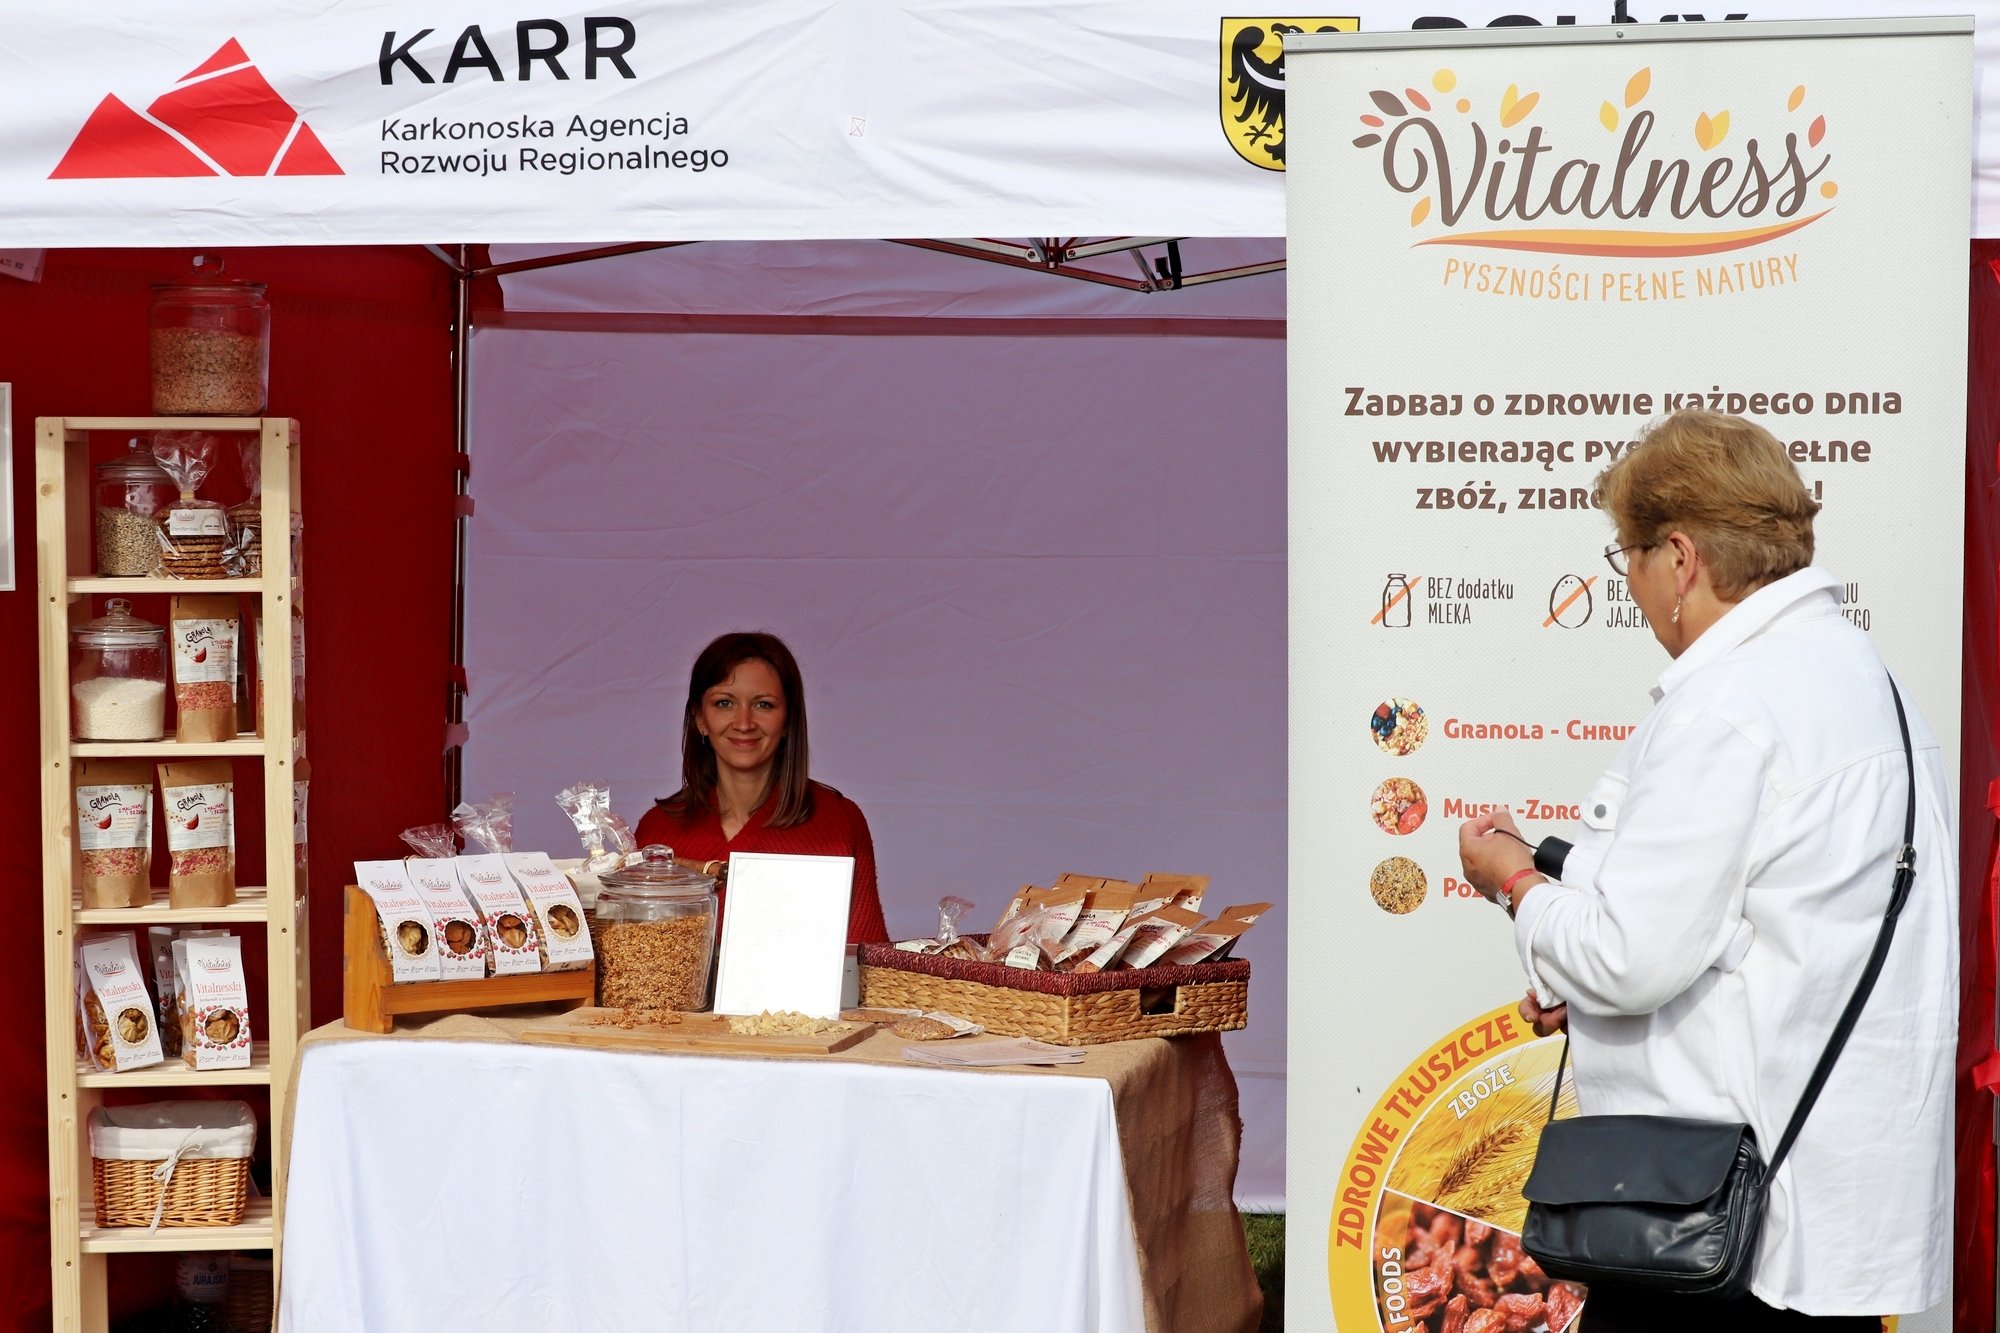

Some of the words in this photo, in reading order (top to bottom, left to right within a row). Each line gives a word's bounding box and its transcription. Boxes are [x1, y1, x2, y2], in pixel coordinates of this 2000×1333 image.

[379, 16, 637, 86] KARR
[381, 115, 555, 141] Karkonoska
[566, 112, 689, 142] Agencja
[381, 148, 507, 177] Rozwoju
[520, 144, 729, 175] Regionalnego
[1383, 109, 1832, 227] Vitalness
[1443, 258, 1590, 301] PYSZNOŚCI
[1602, 270, 1686, 301] PEŁNE
[1696, 253, 1798, 297] NATURY
[1428, 577, 1453, 598] BEZ
[1457, 578, 1513, 600] dodatku
[1428, 602, 1471, 625] MLEKA
[185, 626, 213, 642] GRANOLA
[89, 792, 122, 809] GRANOLA
[176, 792, 206, 809] GRANOLA
[476, 891, 519, 902] Vitalnesski
[526, 882, 569, 894] Vitalnesski
[377, 898, 420, 909] Vitalnesski
[425, 898, 468, 909] Vitalnesski
[99, 981, 142, 998] Vitalnesski
[195, 981, 242, 994] Vitalnesski
[1447, 1064, 1517, 1120] ZBOŻE
[1337, 1116, 1399, 1250] ZDROWE
[1384, 1014, 1519, 1121] TŁUSZCZE
[1381, 1247, 1410, 1324] FOODS
